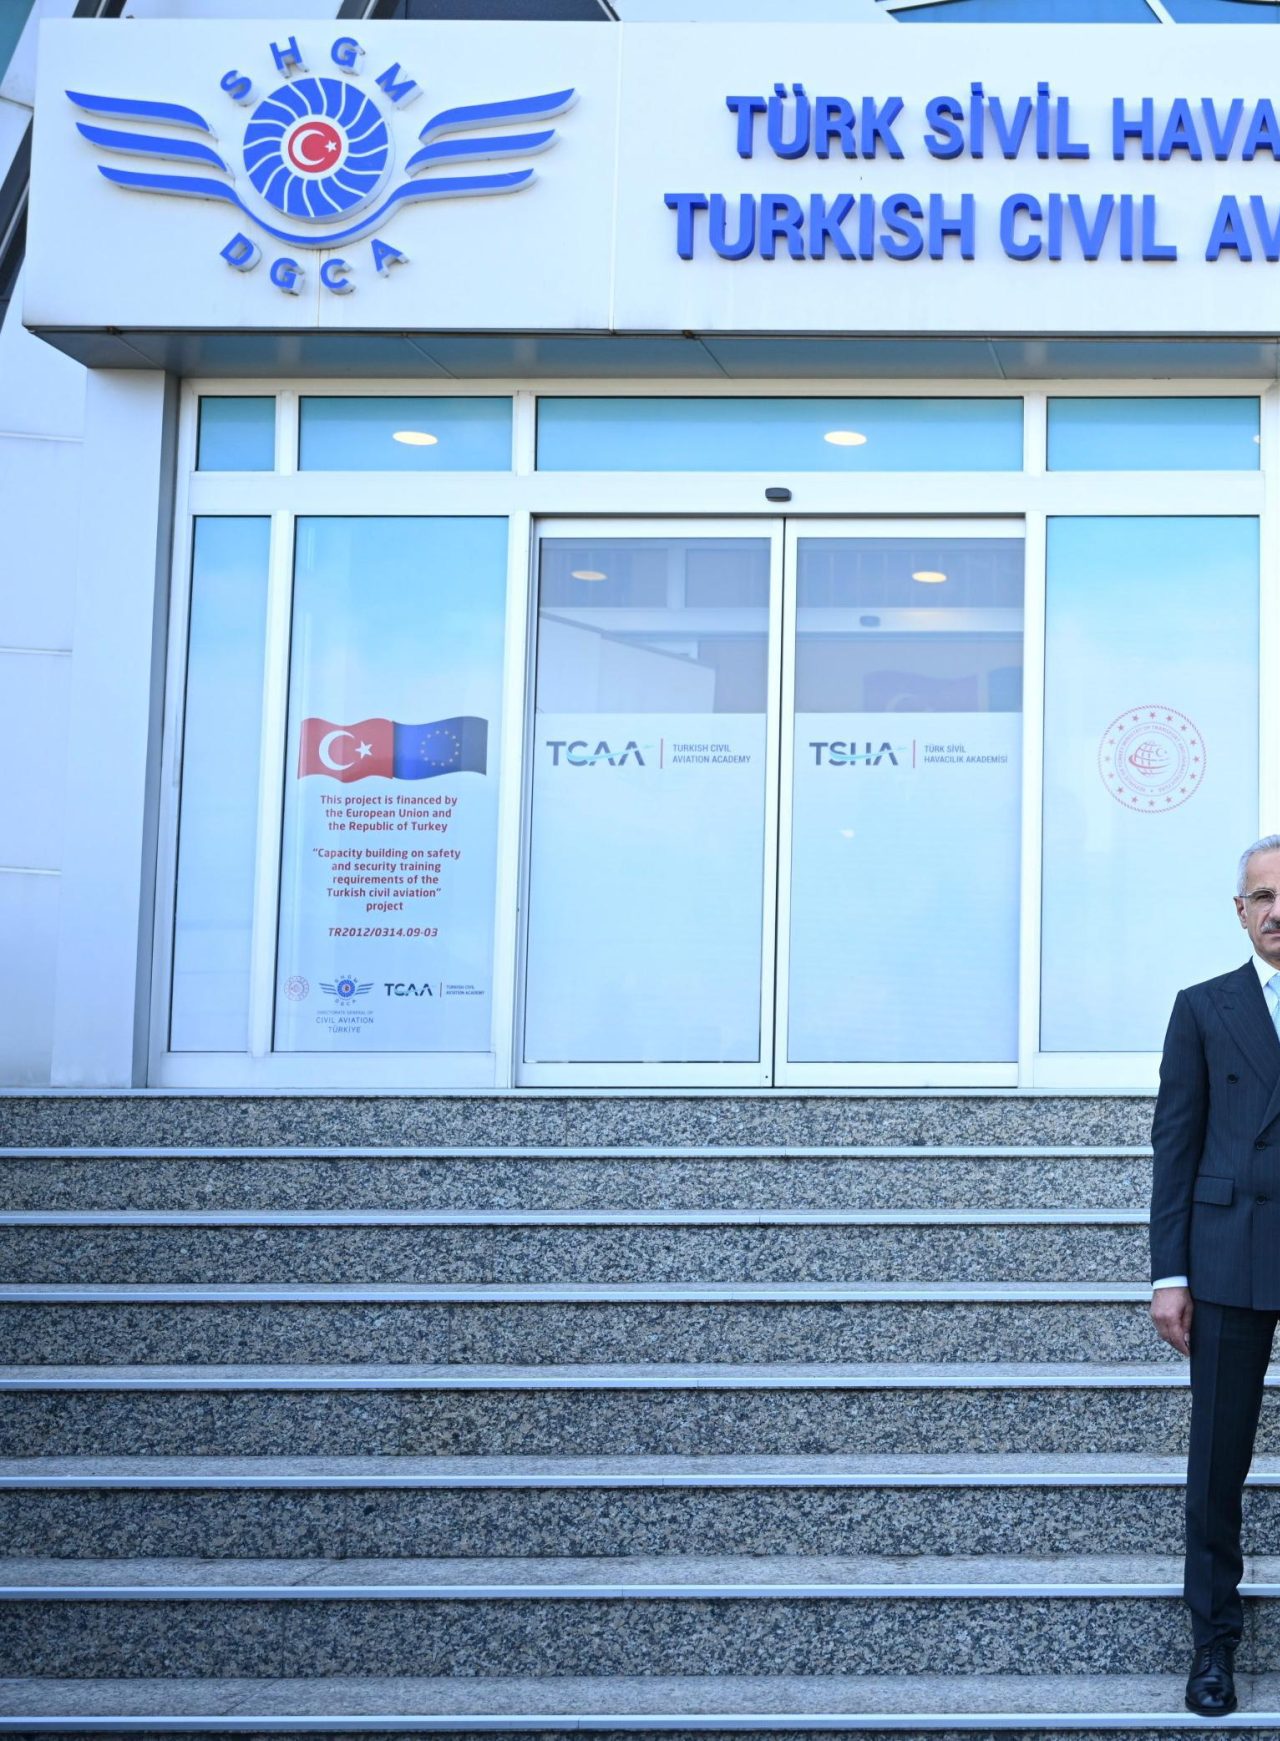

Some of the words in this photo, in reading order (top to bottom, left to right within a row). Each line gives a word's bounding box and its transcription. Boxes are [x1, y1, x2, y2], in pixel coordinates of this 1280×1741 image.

[220, 36, 420, 104] SHGM
[725, 83, 905, 160] TÜRK
[923, 82, 1091, 161] SİVİL
[663, 192, 976, 261] TURKISH
[1000, 192, 1178, 262] CIVIL
[220, 233, 407, 293] DGCA
[546, 740, 645, 767] TCAA
[672, 744, 709, 753] TURKISH
[710, 744, 732, 753] CIVIL
[809, 741, 899, 767] TSHA
[924, 743, 945, 753] TÜRK
[672, 755, 711, 764] AVIATION
[712, 755, 751, 764] ACADEMY
[924, 755, 965, 764] HAVACILIK
[320, 795, 342, 805] This
[344, 795, 382, 807] project
[384, 795, 394, 805] is
[396, 795, 442, 805] financed
[444, 795, 458, 807] by
[325, 808, 343, 818] the
[346, 808, 396, 820] European
[398, 808, 430, 818] Union
[432, 808, 452, 818] and
[328, 821, 346, 831] the
[348, 821, 395, 833] Republic
[397, 821, 409, 831] of
[410, 821, 448, 833] Turkey
[365, 847, 409, 860] building
[411, 850, 424, 858] on
[427, 847, 461, 860] safety
[331, 861, 351, 871] and
[353, 861, 397, 873] security
[399, 861, 441, 873] training
[332, 874, 404, 886] requirements
[406, 874, 419, 885] of
[421, 874, 439, 885] the
[326, 887, 366, 898] Turkish
[368, 887, 391, 898] civil
[365, 901, 404, 913] project
[328, 927, 439, 937] TR2012/0314.09-03
[384, 983, 433, 997] TCAA
[315, 1016, 335, 1024] CIVIL
[338, 1016, 374, 1024] AVIATION
